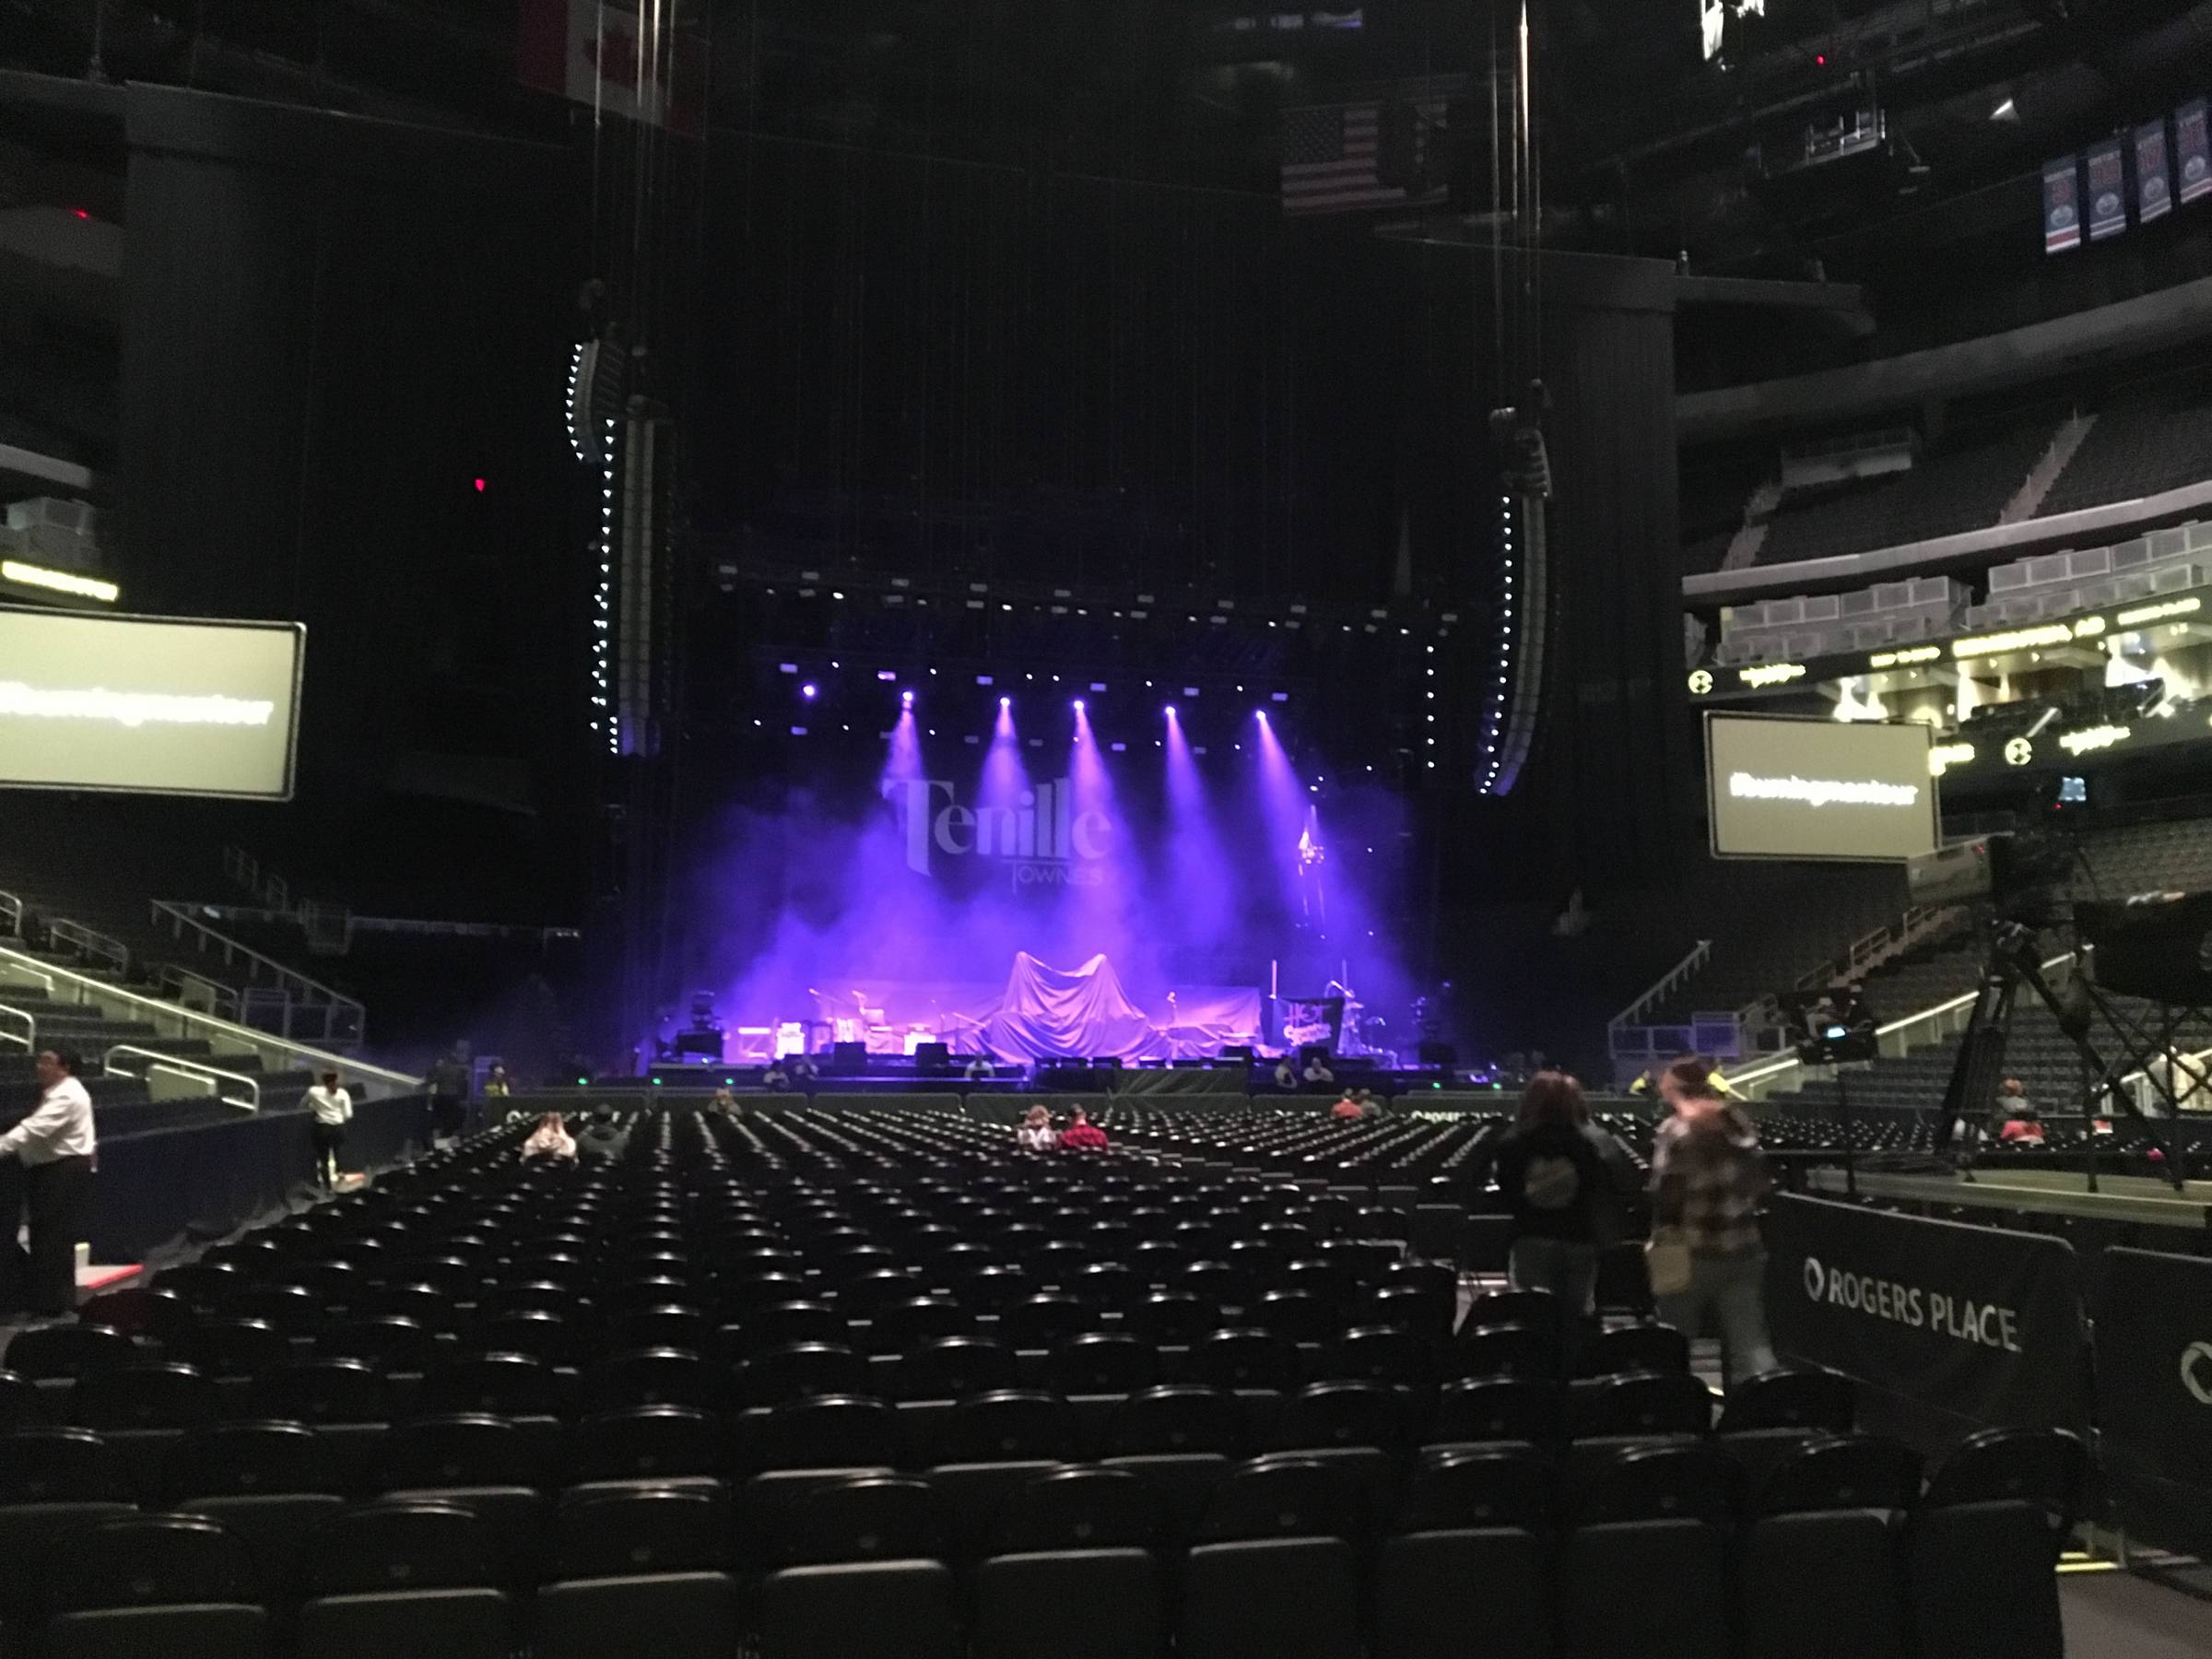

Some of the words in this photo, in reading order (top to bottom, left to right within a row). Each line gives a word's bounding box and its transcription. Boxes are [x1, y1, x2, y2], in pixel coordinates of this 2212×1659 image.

[880, 778, 1112, 877] Tenille
[1828, 1267, 1924, 1327] ROGERS
[1929, 1292, 2023, 1353] PLACE
